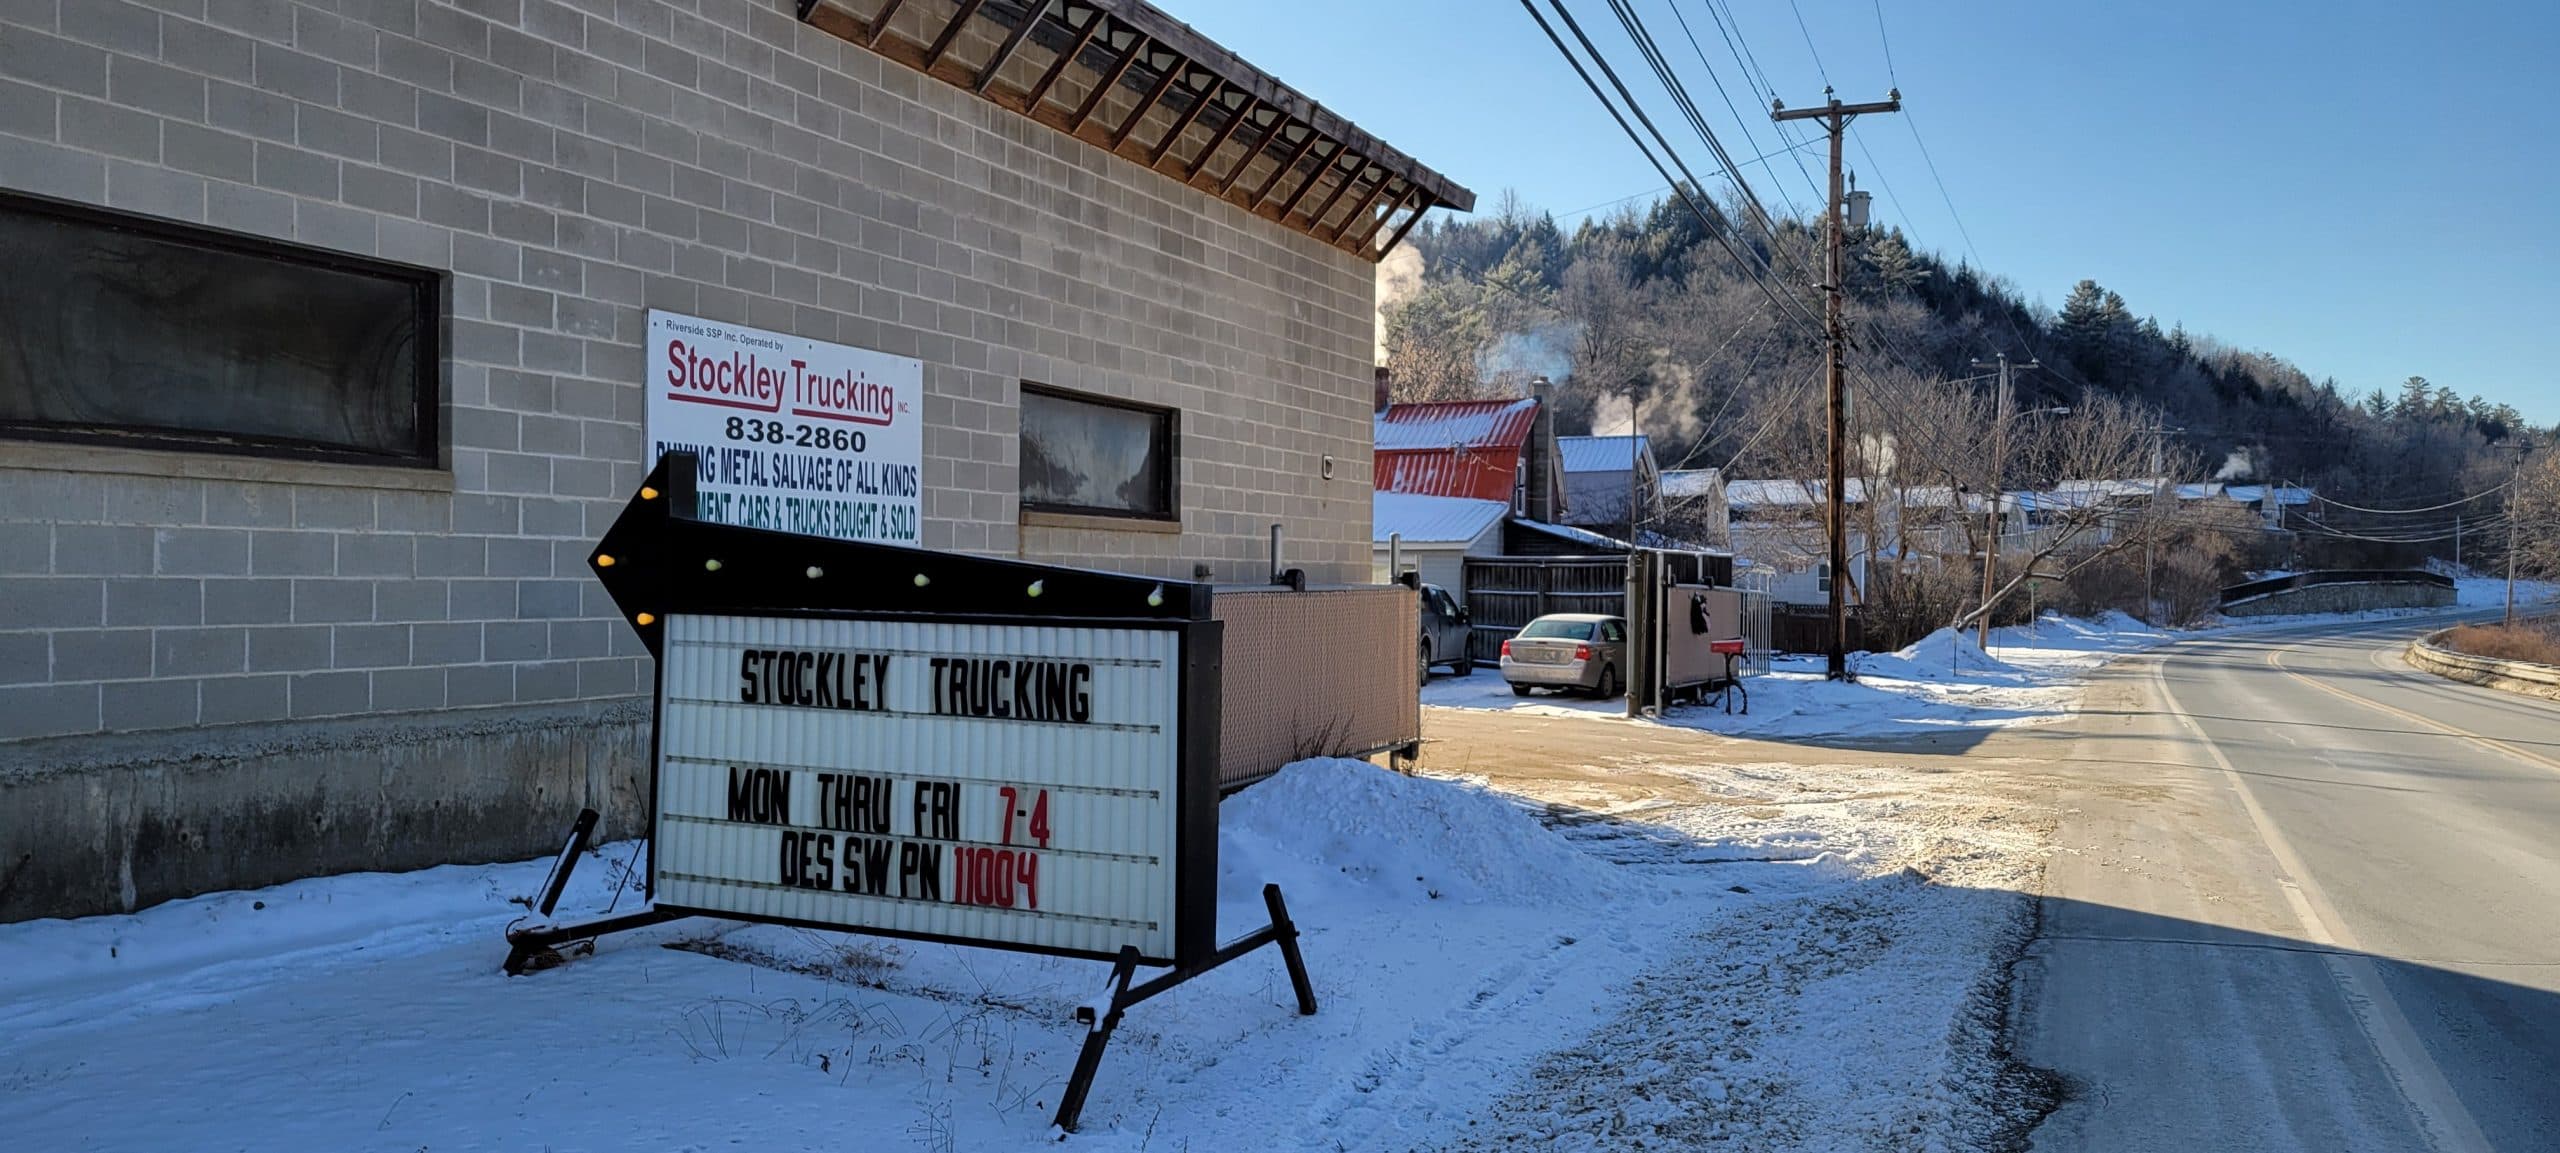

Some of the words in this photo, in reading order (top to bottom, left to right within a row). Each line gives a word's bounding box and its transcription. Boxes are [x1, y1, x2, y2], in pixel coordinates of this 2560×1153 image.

[666, 320, 704, 337] Riverside
[706, 328, 722, 338] SSP
[724, 332, 738, 343] Inc.
[740, 334, 773, 349] Operated
[774, 342, 784, 353] by
[667, 339, 786, 413] Stockley
[790, 359, 893, 427] Trucking
[898, 401, 910, 415] INC.
[725, 416, 867, 453] 838-2860
[720, 447, 768, 487] METAL
[772, 452, 833, 492] SALVAGE
[836, 458, 853, 493] OF
[856, 460, 878, 495] ALL
[882, 463, 917, 498] KINDS
[738, 494, 770, 529] CARS
[773, 496, 782, 530] &
[786, 497, 831, 537] TRUCKS
[834, 500, 878, 539] BOUGHT
[880, 504, 888, 539] &
[891, 504, 916, 540] SOLD
[740, 650, 890, 711] STOCKLEY
[929, 657, 1091, 723] TRUCKING
[727, 766, 790, 825] MON
[817, 773, 892, 834] THRU
[914, 781, 960, 840] FRI
[1000, 787, 1050, 848] 7-4
[780, 831, 833, 890] DES
[842, 838, 893, 896] SW
[900, 841, 941, 900] PN
[953, 846, 1038, 909] 11004
